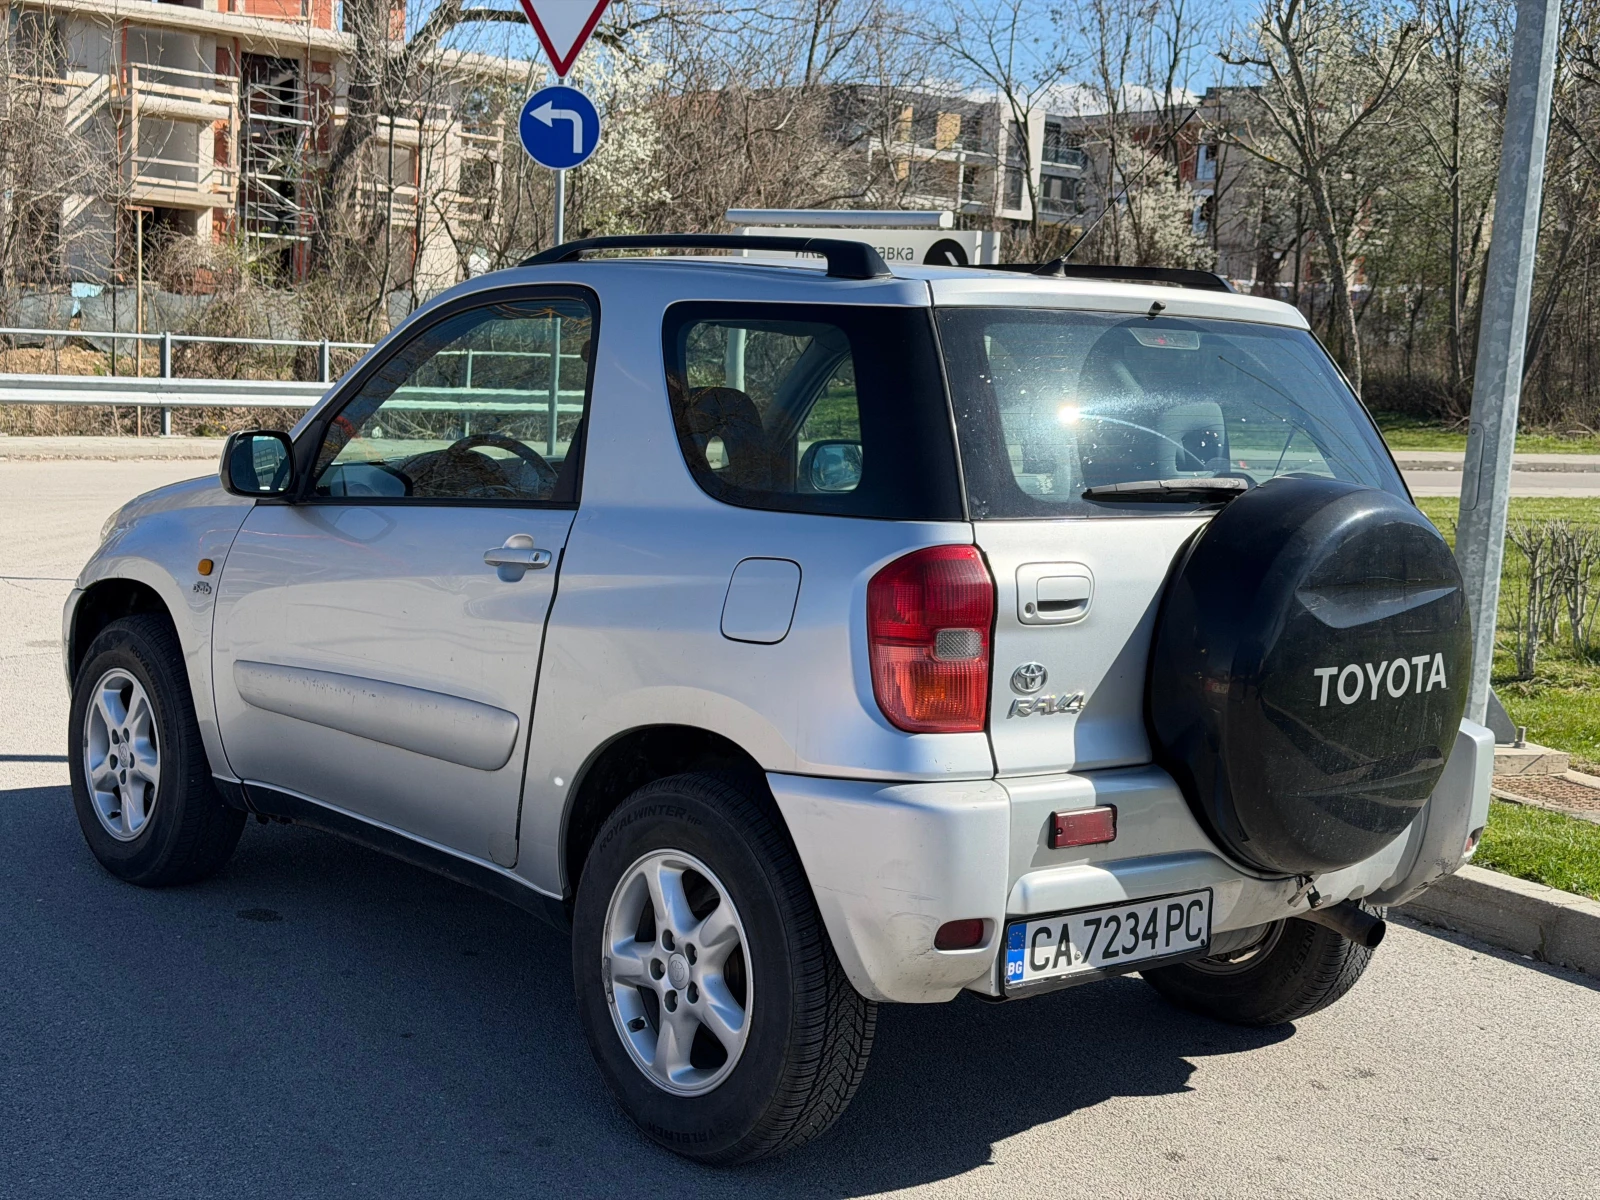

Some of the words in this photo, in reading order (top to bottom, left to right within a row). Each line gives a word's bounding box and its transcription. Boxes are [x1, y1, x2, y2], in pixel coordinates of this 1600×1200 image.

[874, 246, 914, 261] авка
[1313, 652, 1447, 707] TOYOTA
[1006, 690, 1085, 719] RAV4
[1081, 906, 1159, 964] 7234
[1007, 960, 1023, 976] BG
